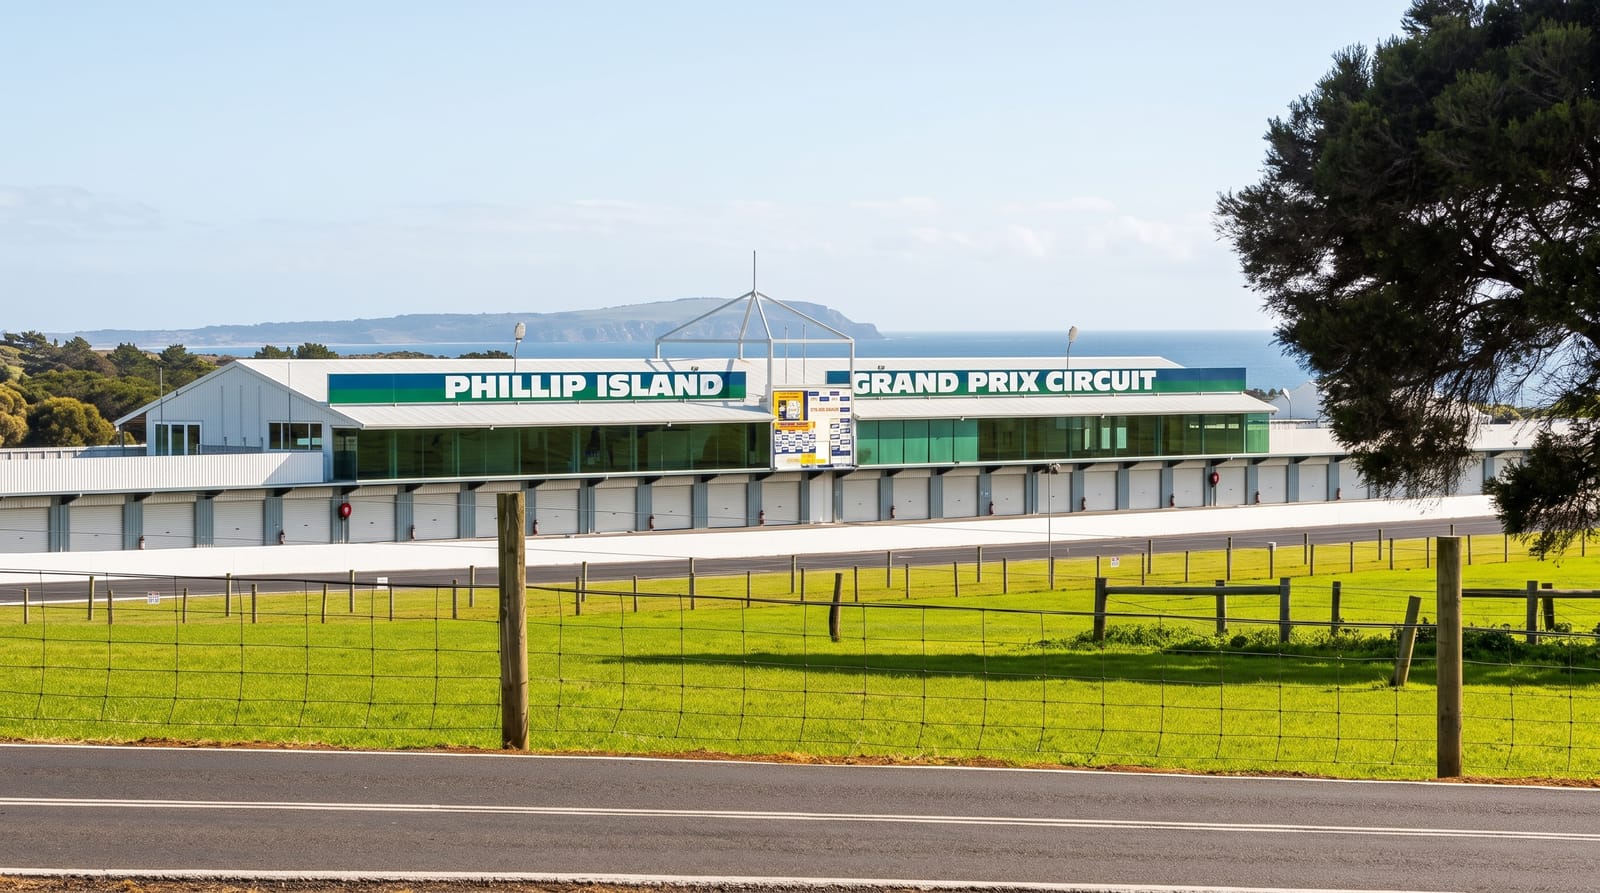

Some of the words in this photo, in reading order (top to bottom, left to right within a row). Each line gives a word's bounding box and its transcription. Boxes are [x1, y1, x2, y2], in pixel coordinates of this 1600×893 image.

[445, 375, 587, 399] PHILLIP
[597, 374, 724, 398] ISLAND
[854, 372, 959, 395] GRAND
[968, 371, 1040, 392] PRIX
[1046, 370, 1157, 391] CIRCUIT
